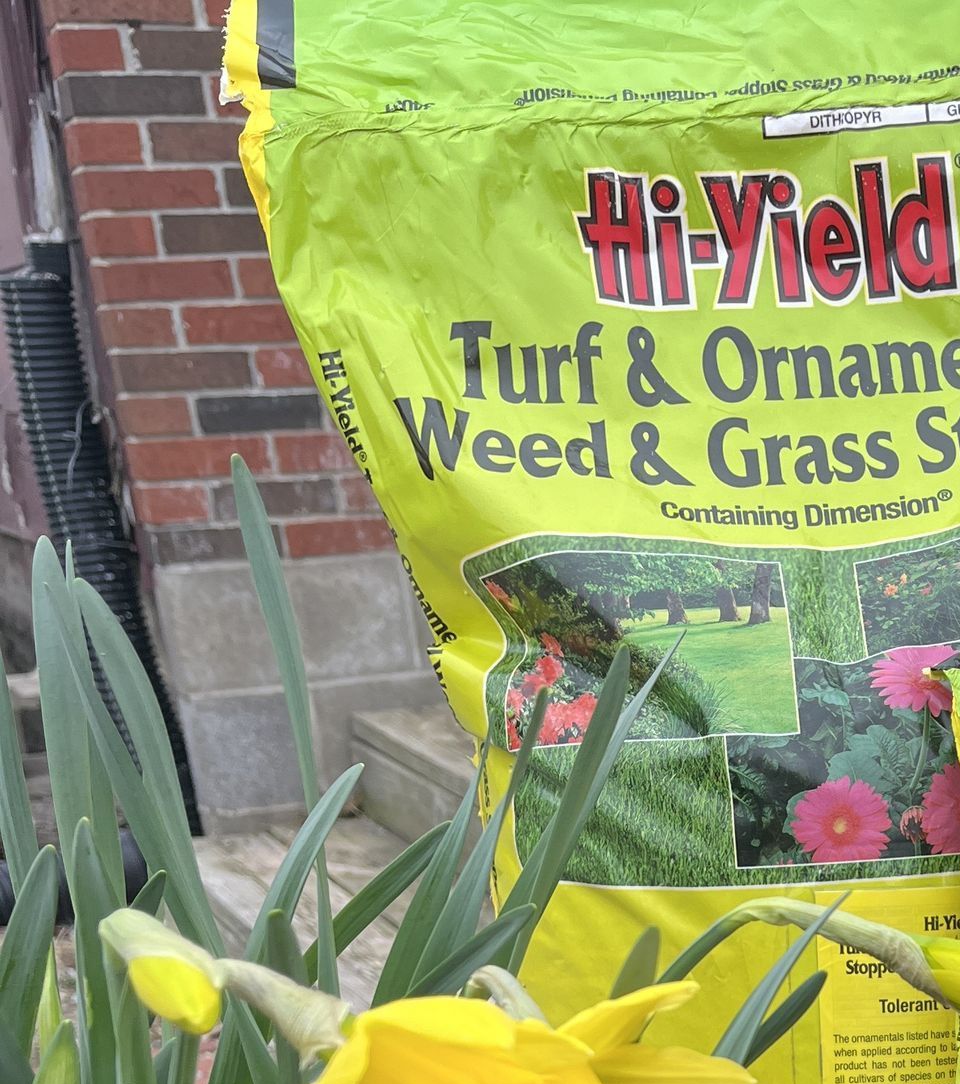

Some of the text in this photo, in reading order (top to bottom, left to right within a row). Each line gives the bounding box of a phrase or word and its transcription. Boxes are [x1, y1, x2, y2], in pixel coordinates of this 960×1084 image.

[449, 319, 604, 407] Turf
[626, 332, 683, 407] &
[395, 396, 613, 483] Weed
[629, 420, 697, 486] &
[707, 414, 900, 490] Grass
[660, 488, 954, 531] Containing Dimension®
[879, 998, 938, 1014] Tolerant
[833, 1029, 948, 1044] The ornamentals listed have
[833, 1043, 937, 1058] when applied according
[834, 1057, 931, 1073] product has not been
[848, 1070, 932, 1084] cultivars species
